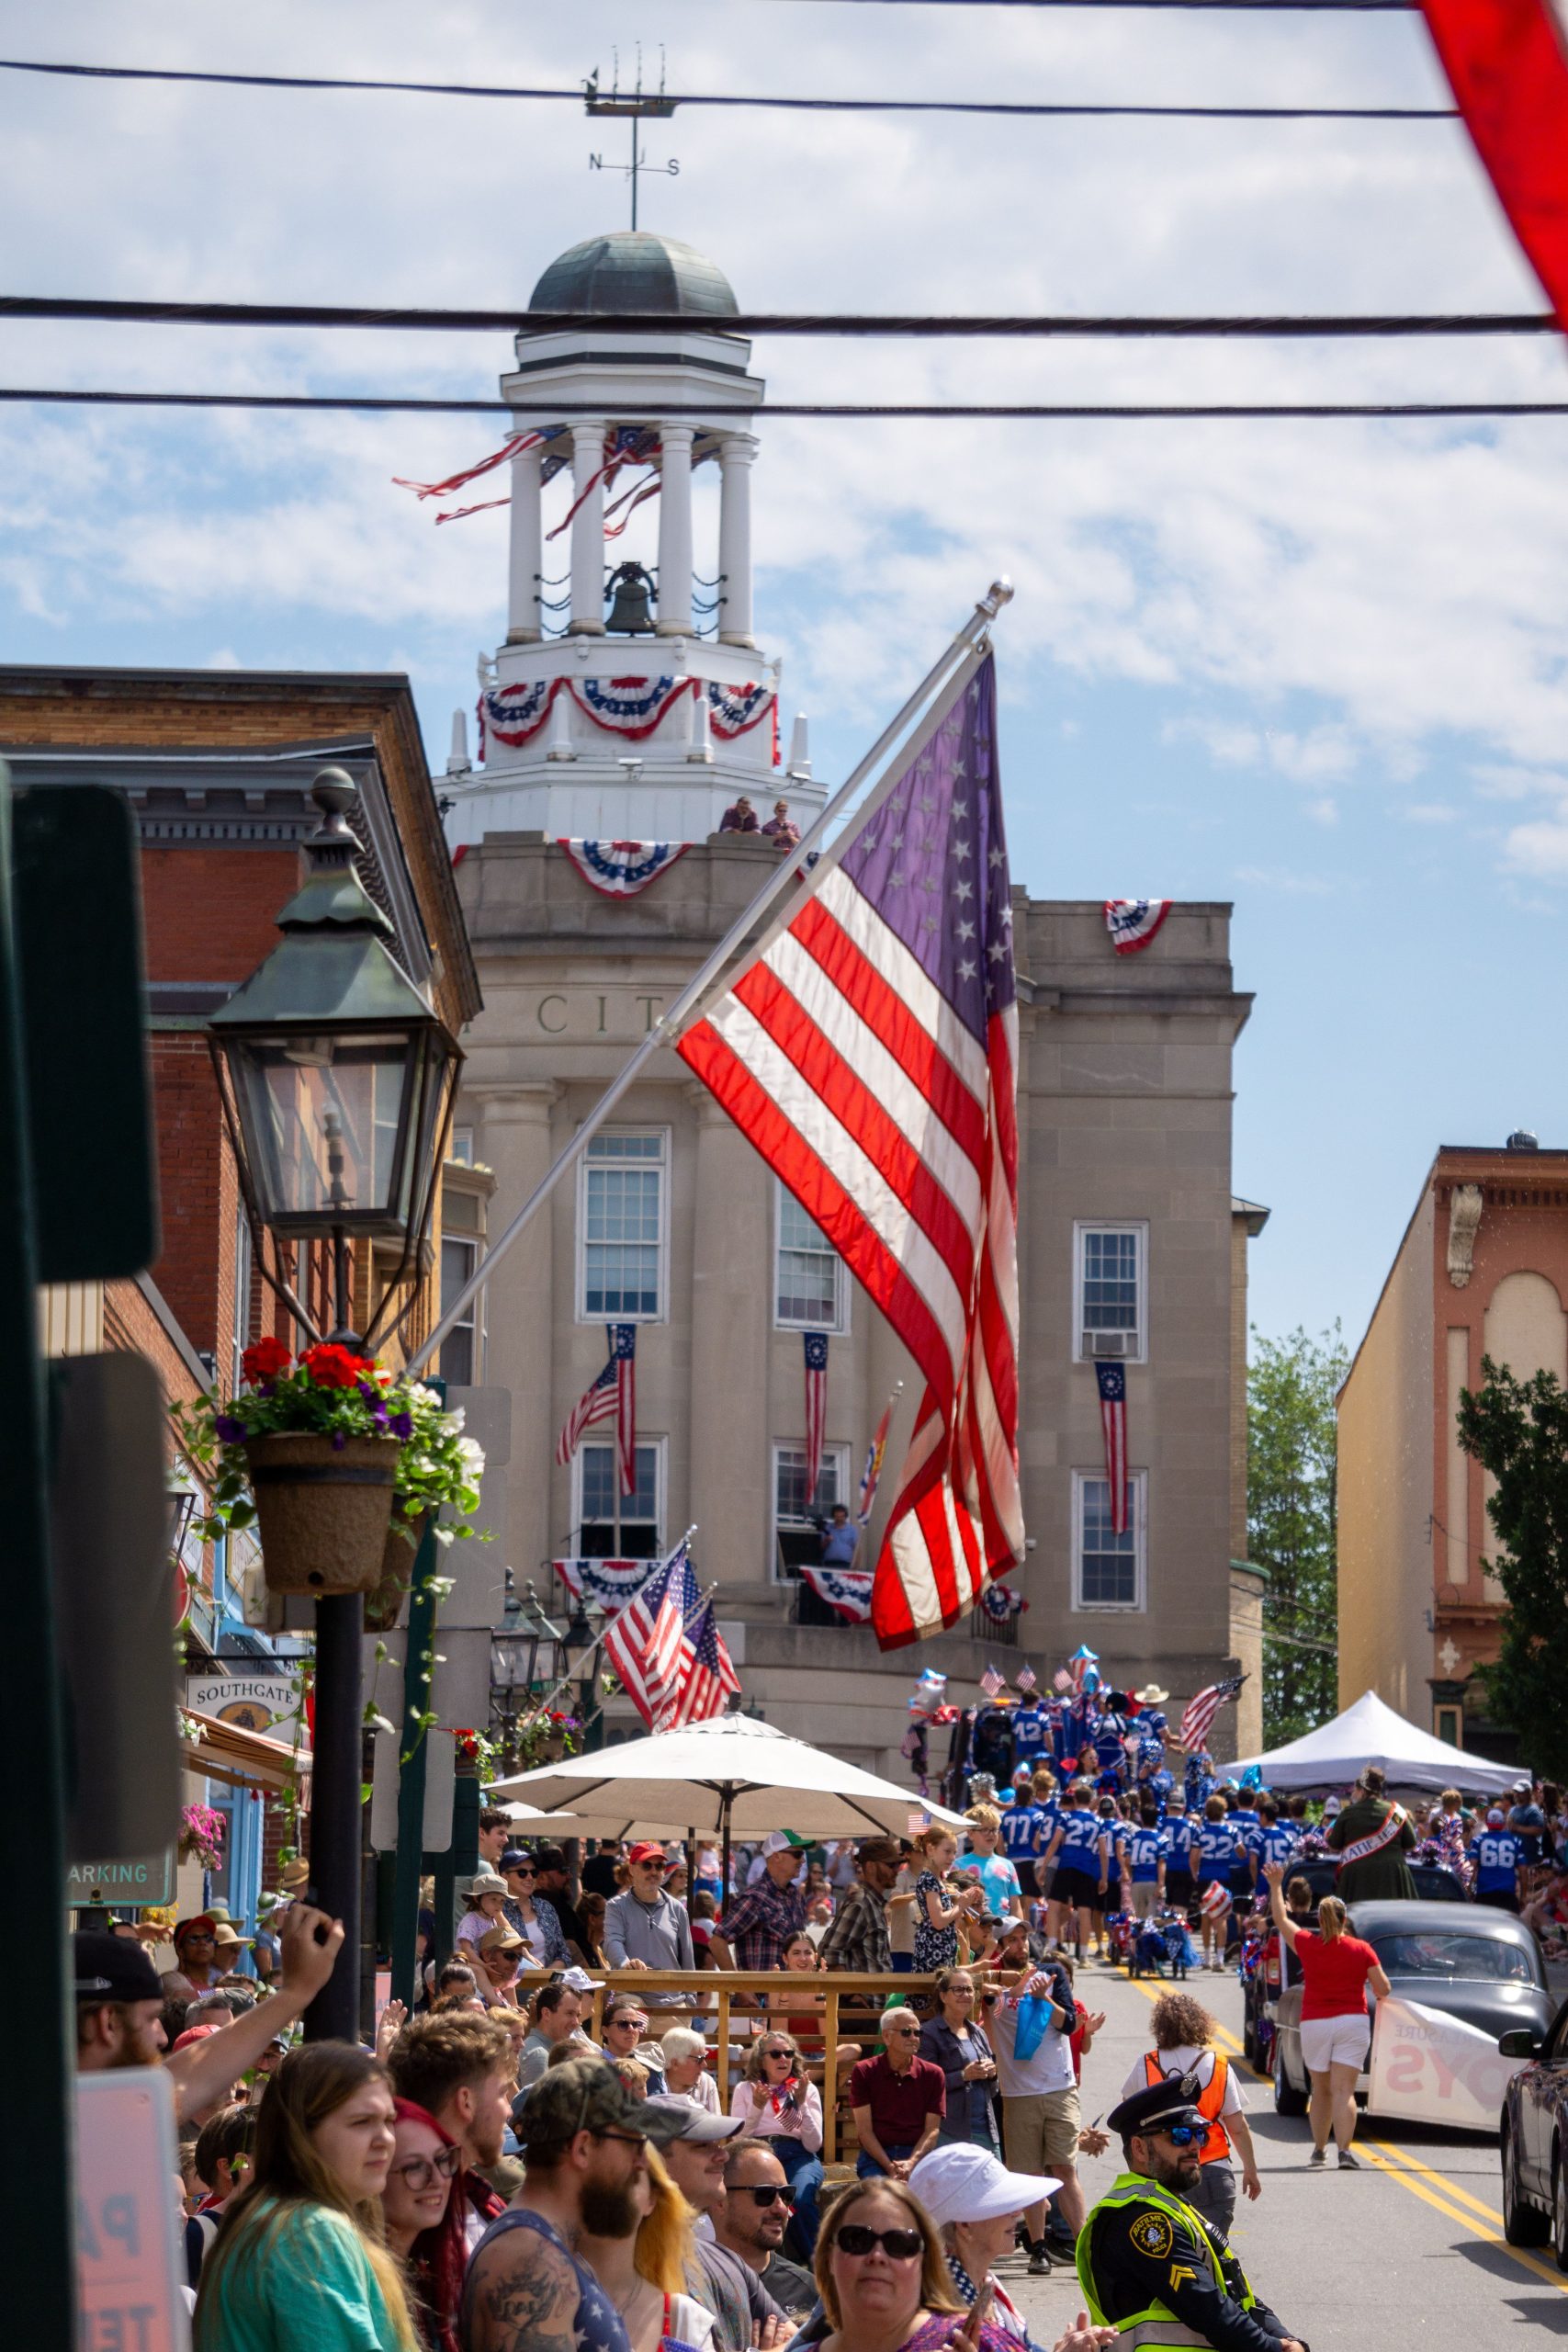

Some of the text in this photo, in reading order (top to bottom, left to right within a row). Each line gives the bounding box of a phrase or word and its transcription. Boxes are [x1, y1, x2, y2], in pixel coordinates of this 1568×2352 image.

[589, 153, 602, 170] N
[668, 158, 680, 175] S
[536, 995, 703, 1034] CIT
[197, 1682, 293, 1704] SOUTHGATE
[1003, 1815, 1032, 1845] 77
[1065, 1818, 1100, 1849] 27
[1130, 1838, 1158, 1866] 16
[1199, 1834, 1234, 1859] 22
[1480, 1838, 1516, 1868] 66
[67, 1864, 148, 1883] ARKING
